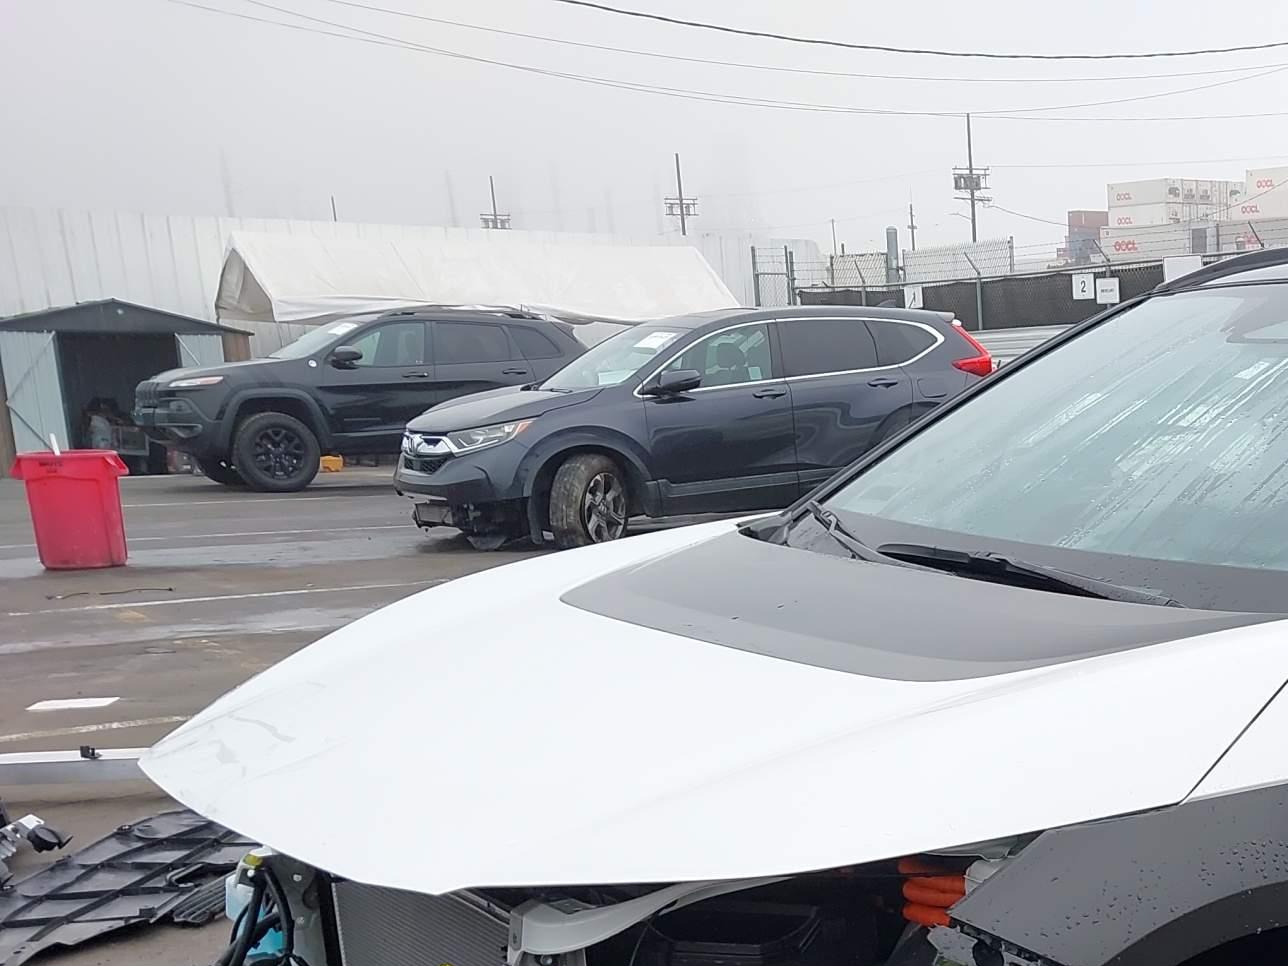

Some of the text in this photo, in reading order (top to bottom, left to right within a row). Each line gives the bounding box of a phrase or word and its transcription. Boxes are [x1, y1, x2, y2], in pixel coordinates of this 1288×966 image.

[1256, 179, 1275, 189] OOCL
[1241, 204, 1260, 214] OOCL
[1080, 280, 1087, 293] 2
